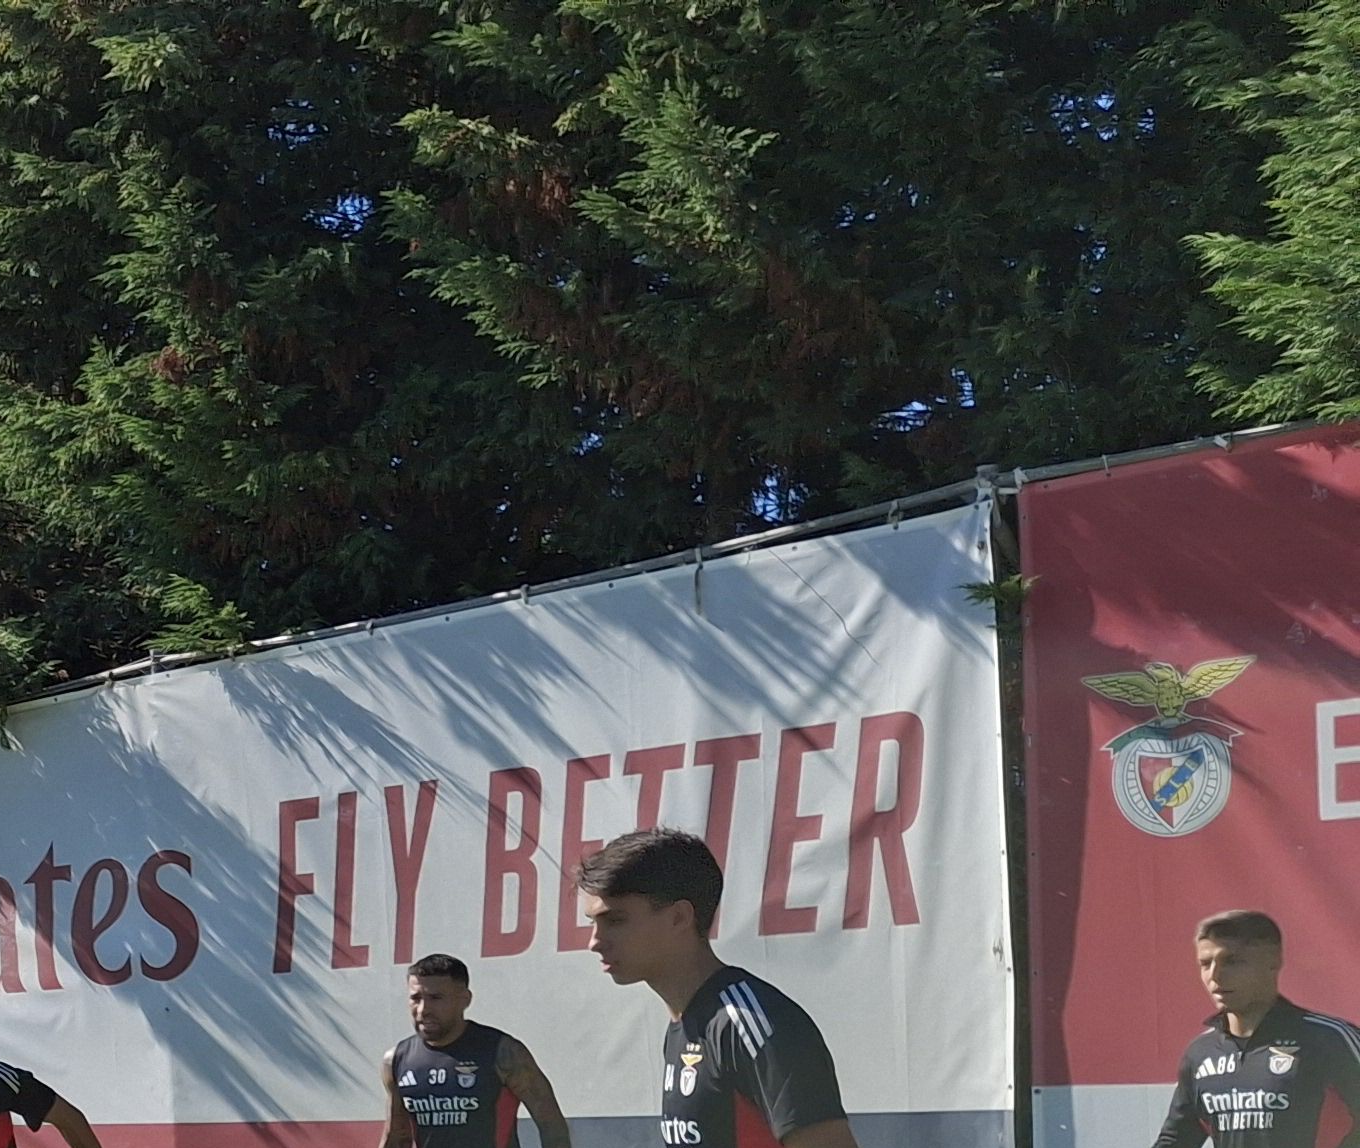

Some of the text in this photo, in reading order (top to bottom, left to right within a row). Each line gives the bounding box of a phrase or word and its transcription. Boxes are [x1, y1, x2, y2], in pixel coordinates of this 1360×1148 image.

[272, 779, 440, 975] FLY
[479, 711, 926, 958] BETTER
[1216, 1053, 1236, 1075] 86
[428, 1068, 447, 1085] 30
[402, 1094, 479, 1113] Emirates
[1201, 1087, 1290, 1114] Emirates
[416, 1111, 468, 1126] FLY BETTER
[1231, 1110, 1274, 1131] BETTER
